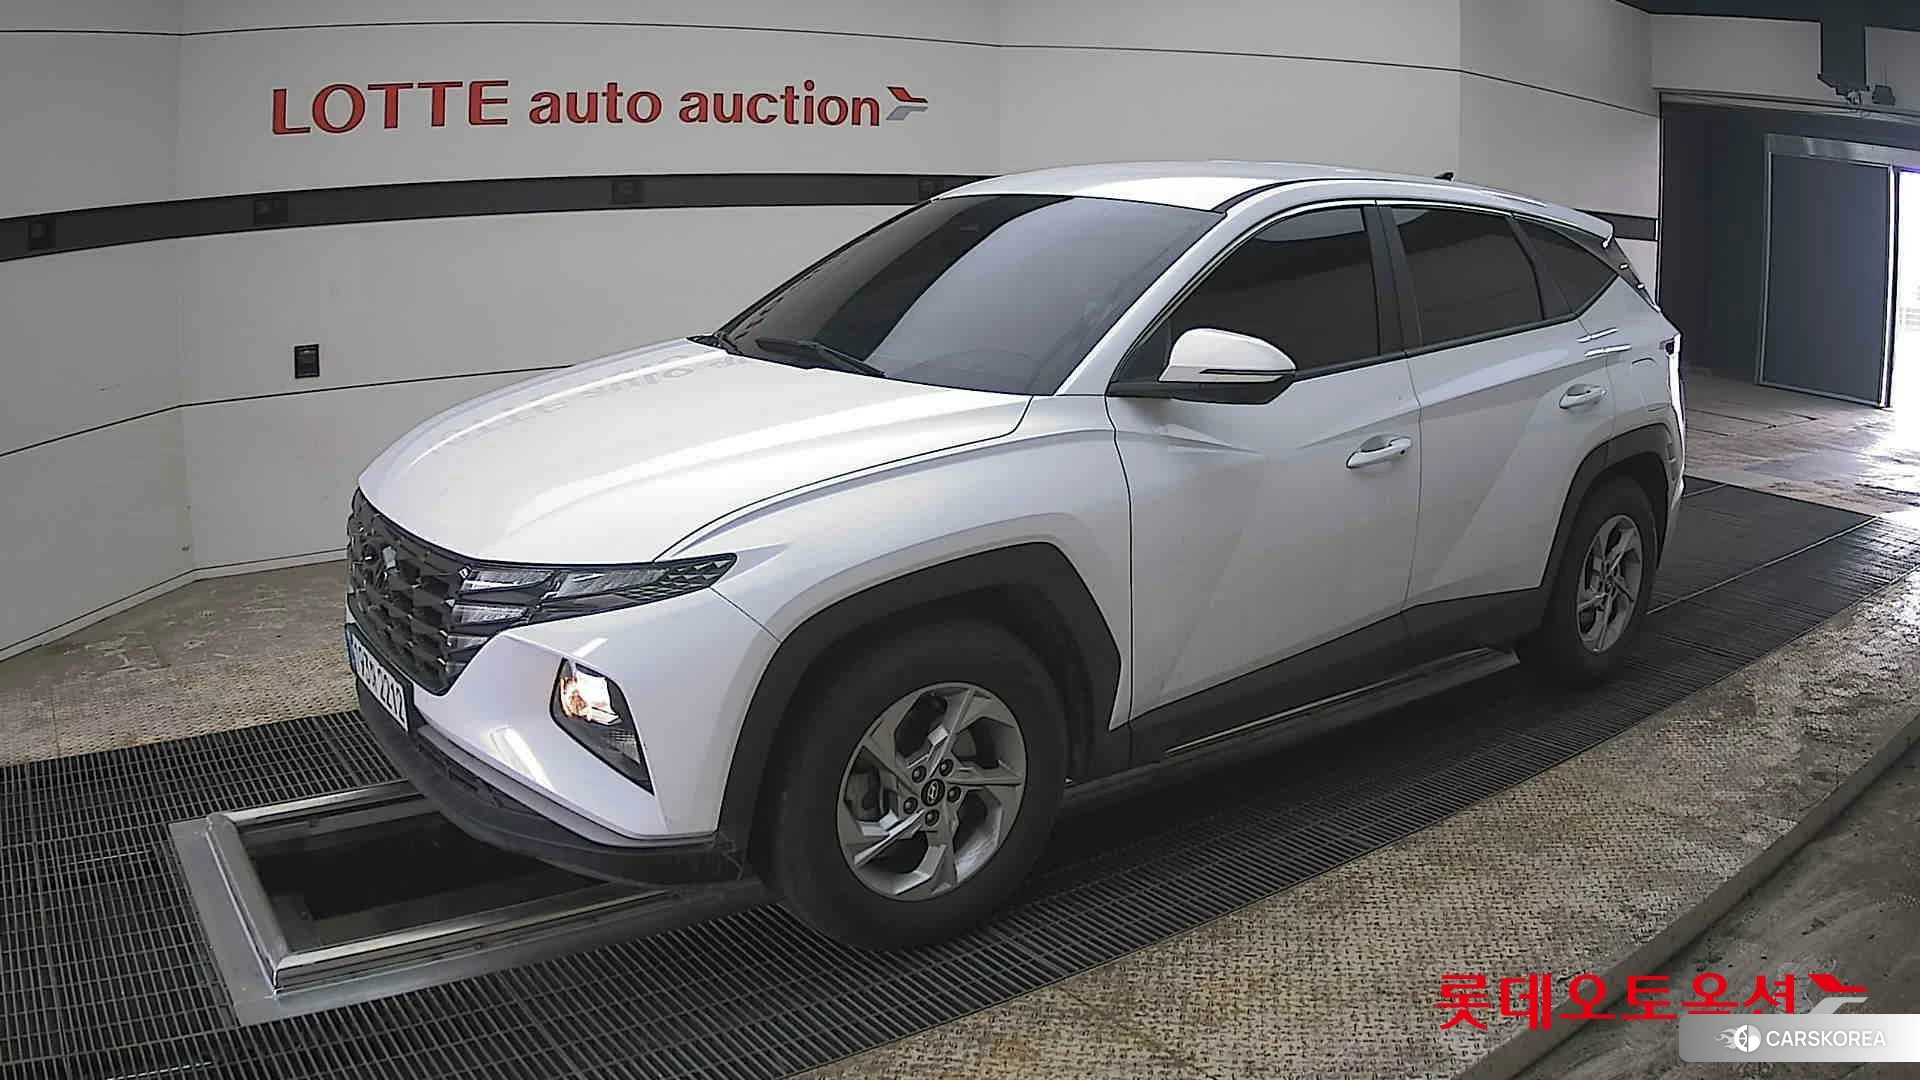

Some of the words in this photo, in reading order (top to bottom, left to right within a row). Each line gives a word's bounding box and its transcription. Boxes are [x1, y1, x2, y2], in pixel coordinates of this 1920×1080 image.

[272, 80, 509, 136] LOTTE
[529, 82, 663, 125] auto
[679, 80, 881, 127] auction
